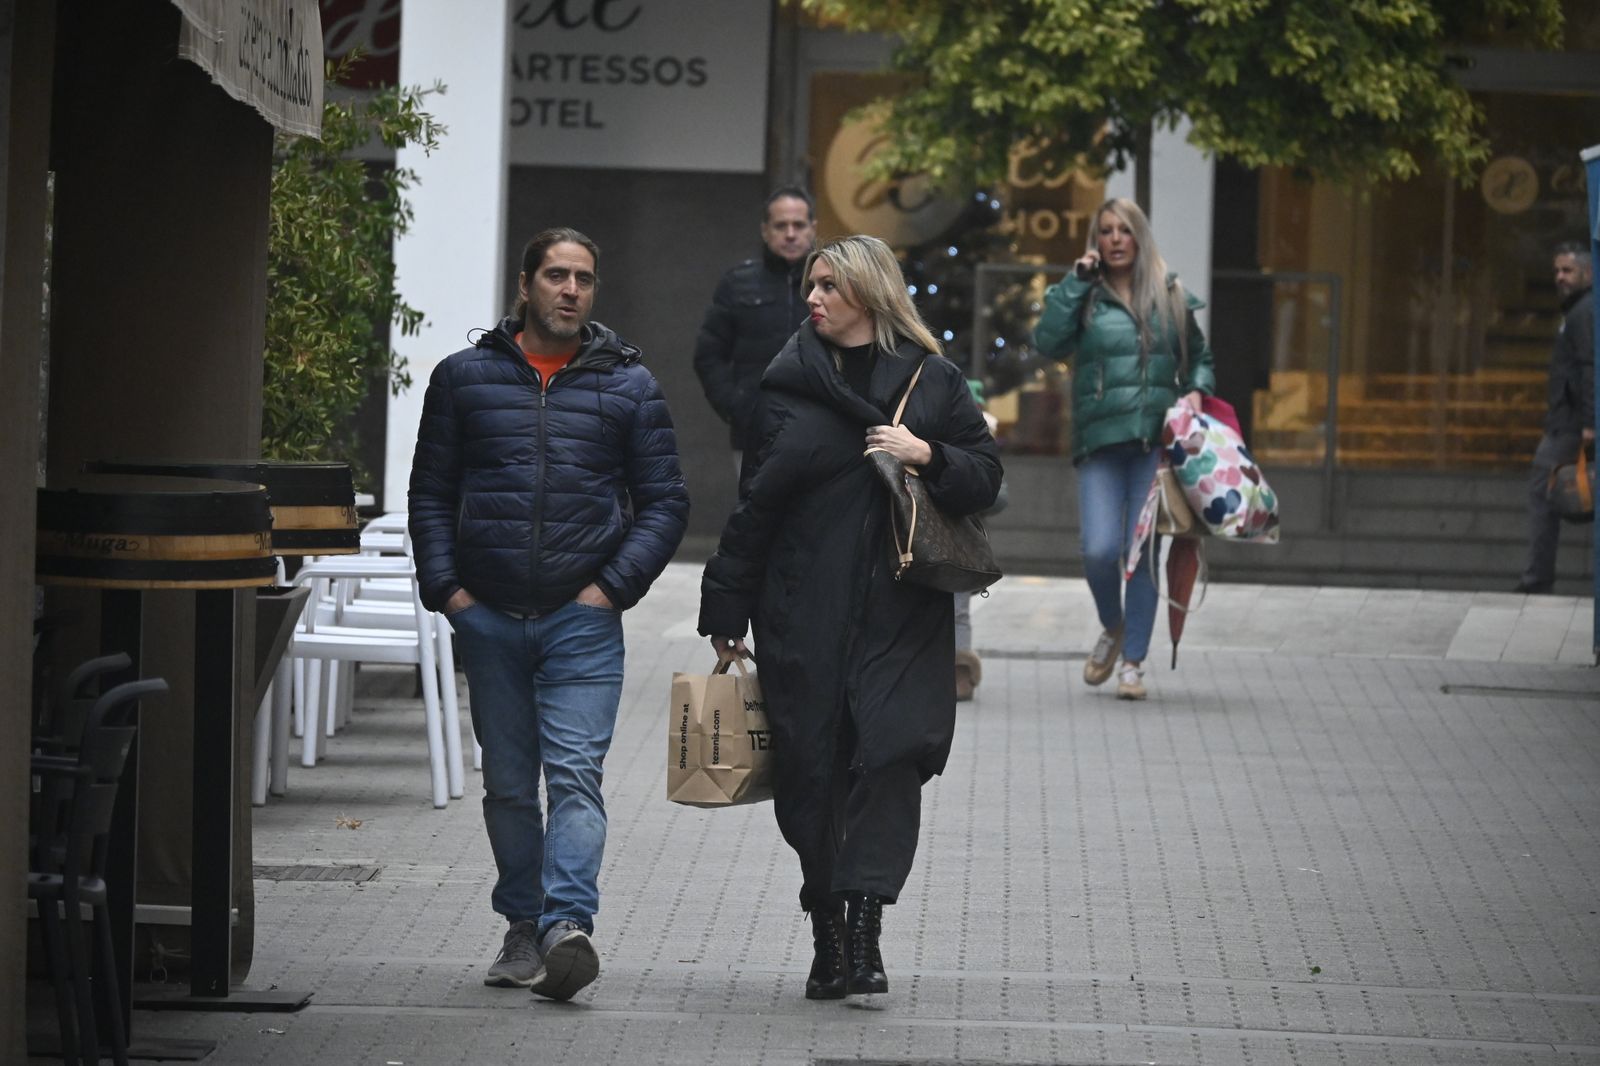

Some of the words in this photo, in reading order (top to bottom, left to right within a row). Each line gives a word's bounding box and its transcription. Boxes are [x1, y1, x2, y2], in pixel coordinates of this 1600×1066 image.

[683, 703, 690, 713] at
[680, 714, 688, 744] online
[711, 709, 720, 766] tezenis.com
[679, 747, 688, 770] Shop
